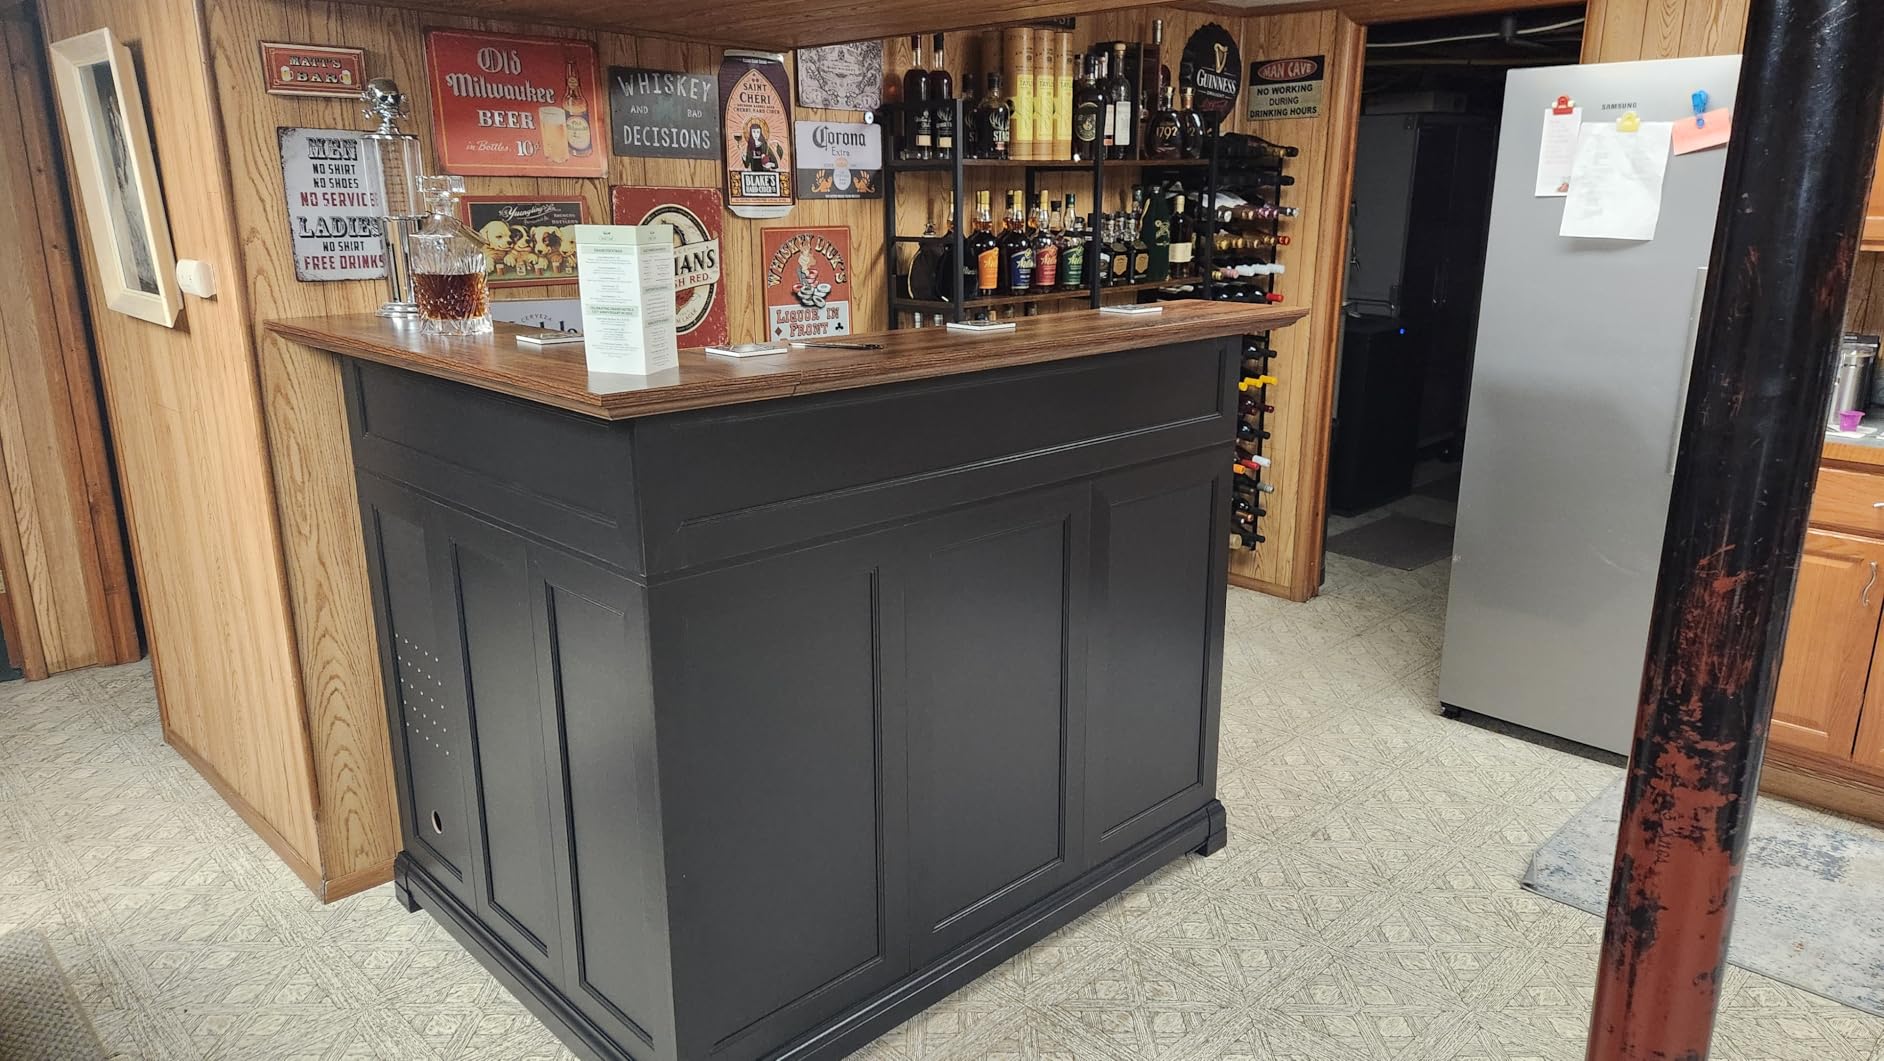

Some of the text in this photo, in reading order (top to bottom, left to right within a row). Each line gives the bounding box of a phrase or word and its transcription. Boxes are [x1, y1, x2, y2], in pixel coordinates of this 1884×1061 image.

[289, 56, 341, 69] MATT'S
[477, 47, 522, 75] Old
[1263, 61, 1312, 78] MAN CAVE
[296, 72, 338, 83] BAR
[1196, 69, 1236, 94] GUINNESS
[445, 72, 555, 104] Milwaukee
[617, 73, 711, 102] WHISKEY
[743, 83, 767, 92] SAINT
[1257, 84, 1313, 96] NO WORKING
[1269, 97, 1299, 106] DURING
[1601, 102, 1637, 110] SAMSUNG
[630, 105, 702, 118] AND BAD
[1250, 106, 1317, 118] DRINKING HOURS
[477, 109, 536, 129] BEER
[623, 125, 711, 149] DECISIONS
[812, 125, 866, 151] Corona
[1156, 126, 1178, 140] 1792
[307, 137, 358, 160] MEN
[313, 164, 356, 175] NO SHIRT
[314, 178, 359, 188] NO SHOES
[745, 175, 775, 187] BLAKE'S
[300, 192, 318, 206] NO
[297, 216, 382, 238] LADIES
[323, 241, 364, 252] NO SHIRT
[304, 255, 385, 270] FREE DRINKS
[768, 234, 848, 288] WHISKEY DICK'S
[521, 313, 552, 323] CERVEZA
[776, 307, 839, 324] LIQUOR IN
[790, 322, 828, 337] FRONT
